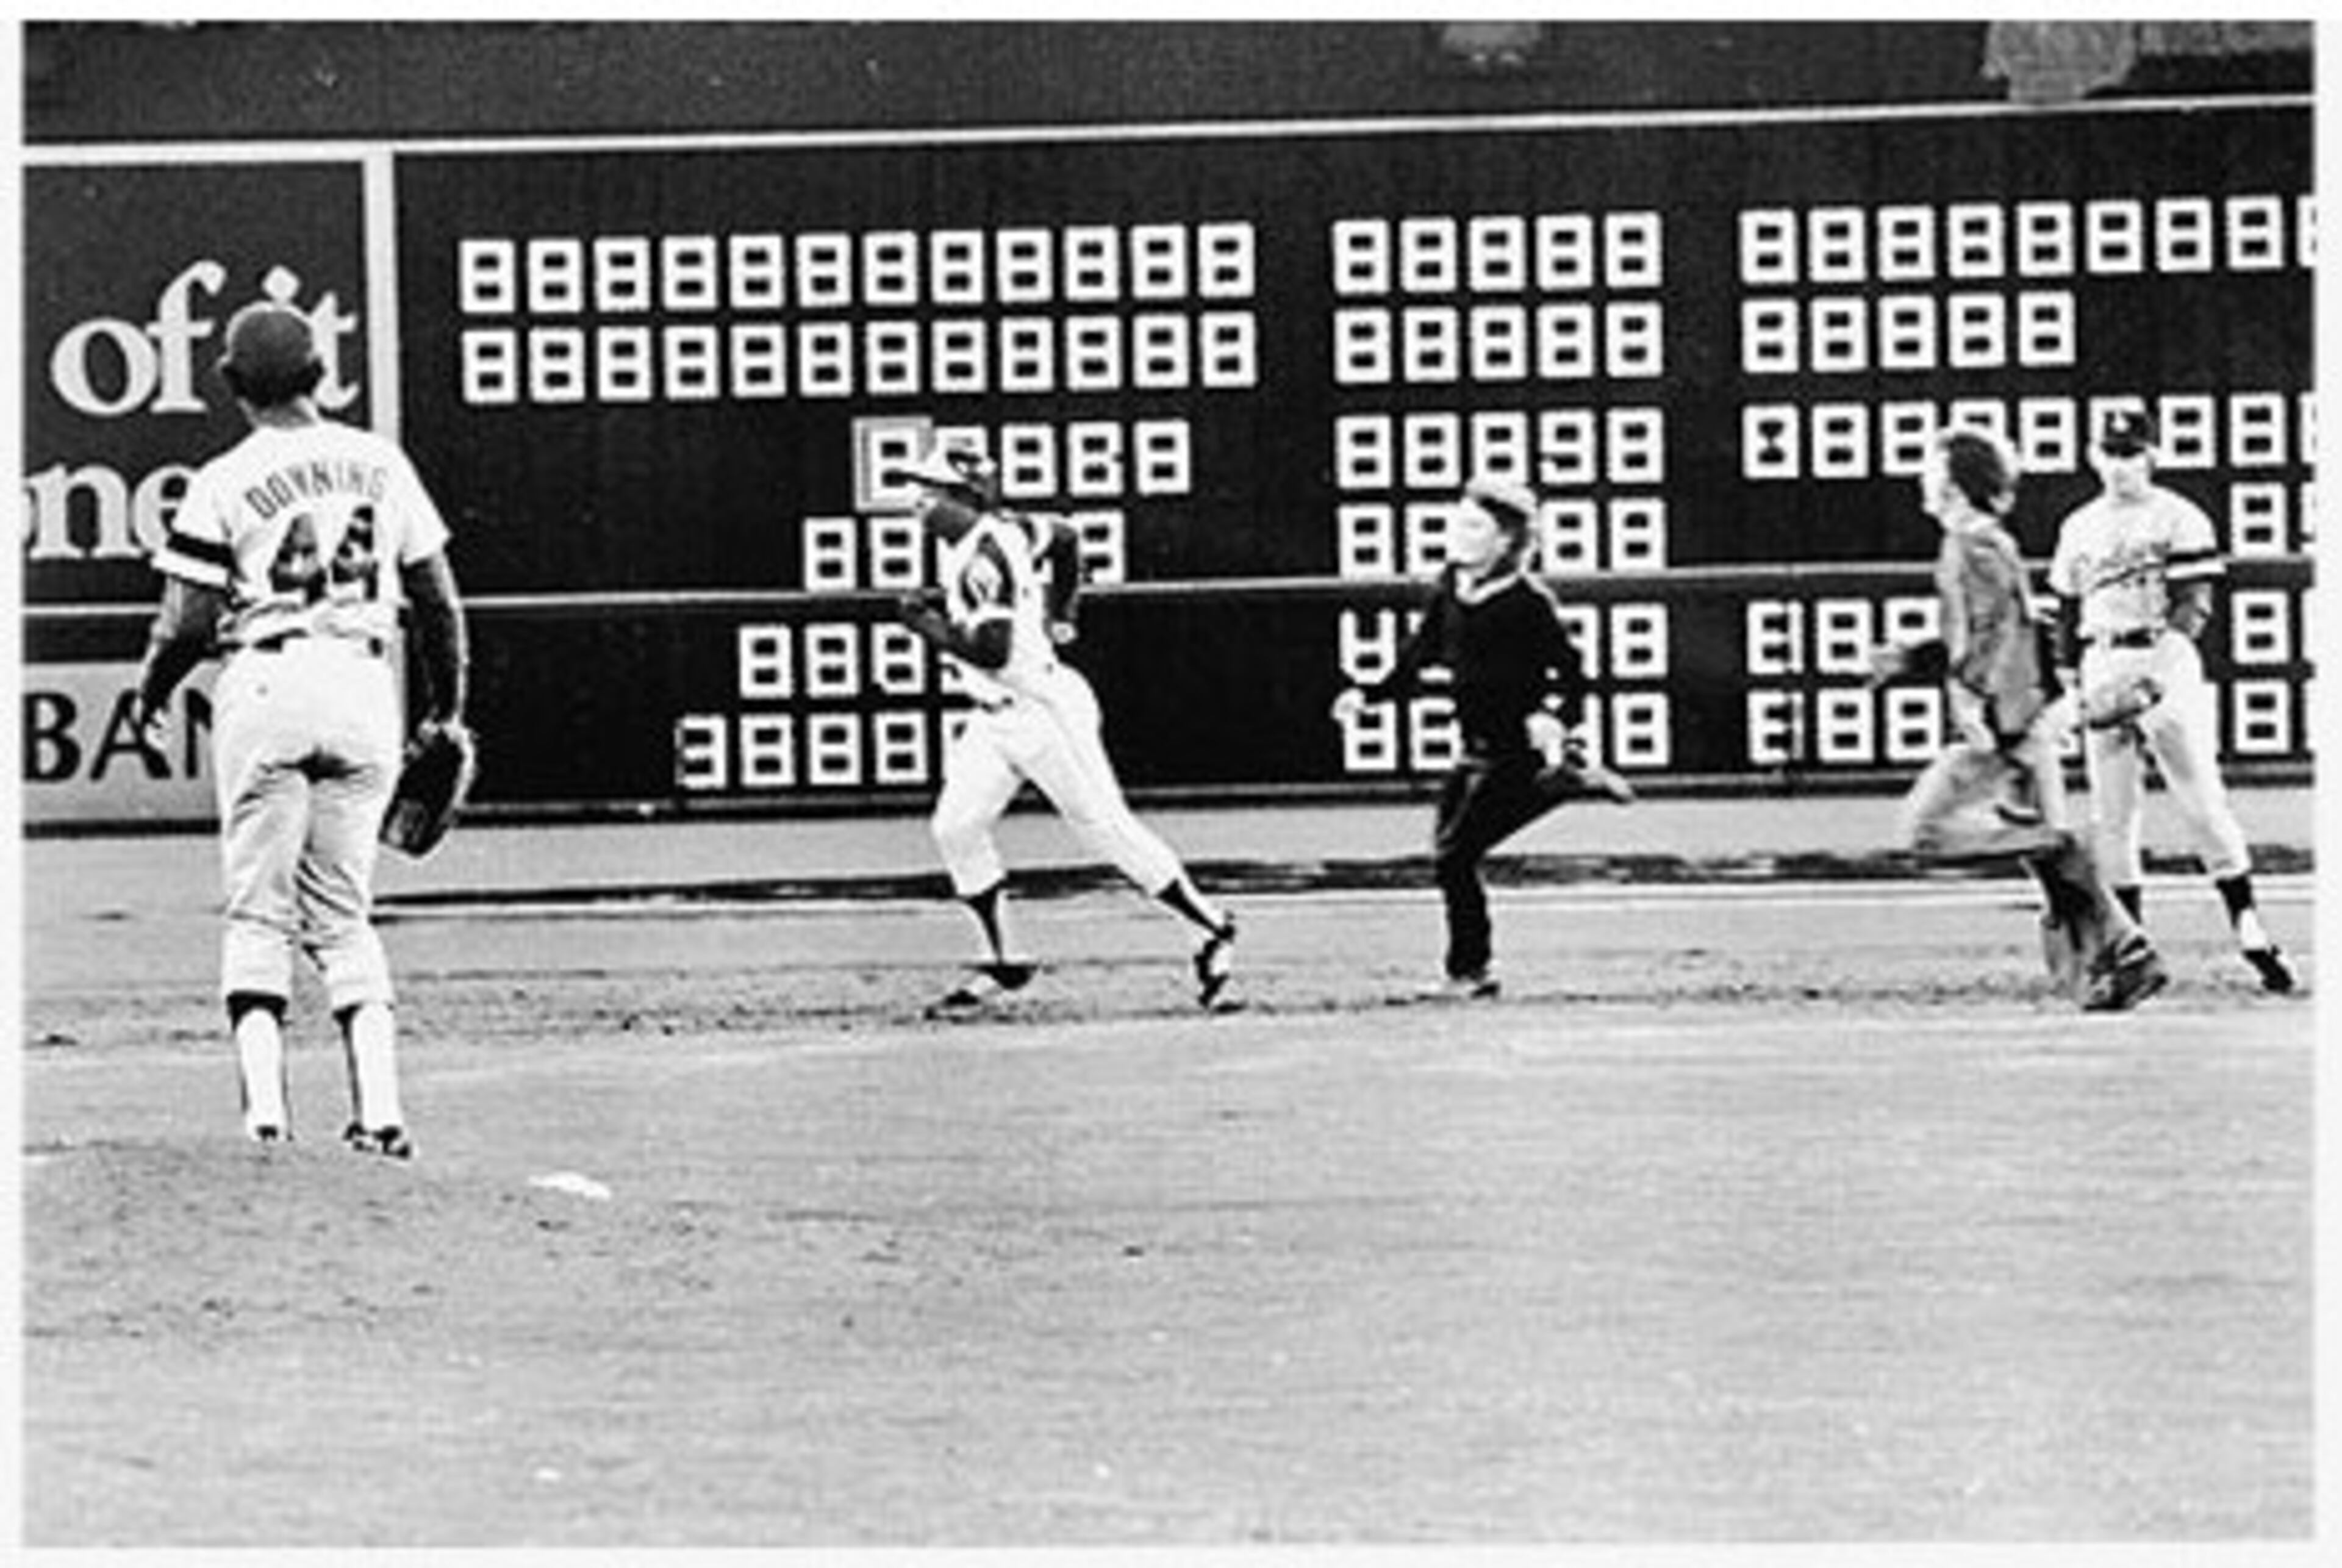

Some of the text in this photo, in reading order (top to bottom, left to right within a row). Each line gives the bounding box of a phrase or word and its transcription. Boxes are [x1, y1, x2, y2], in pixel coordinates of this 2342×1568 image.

[50, 260, 359, 417] of t
[22, 462, 196, 561] ne
[243, 460, 388, 520] DOWNING
[267, 506, 379, 606] 44
